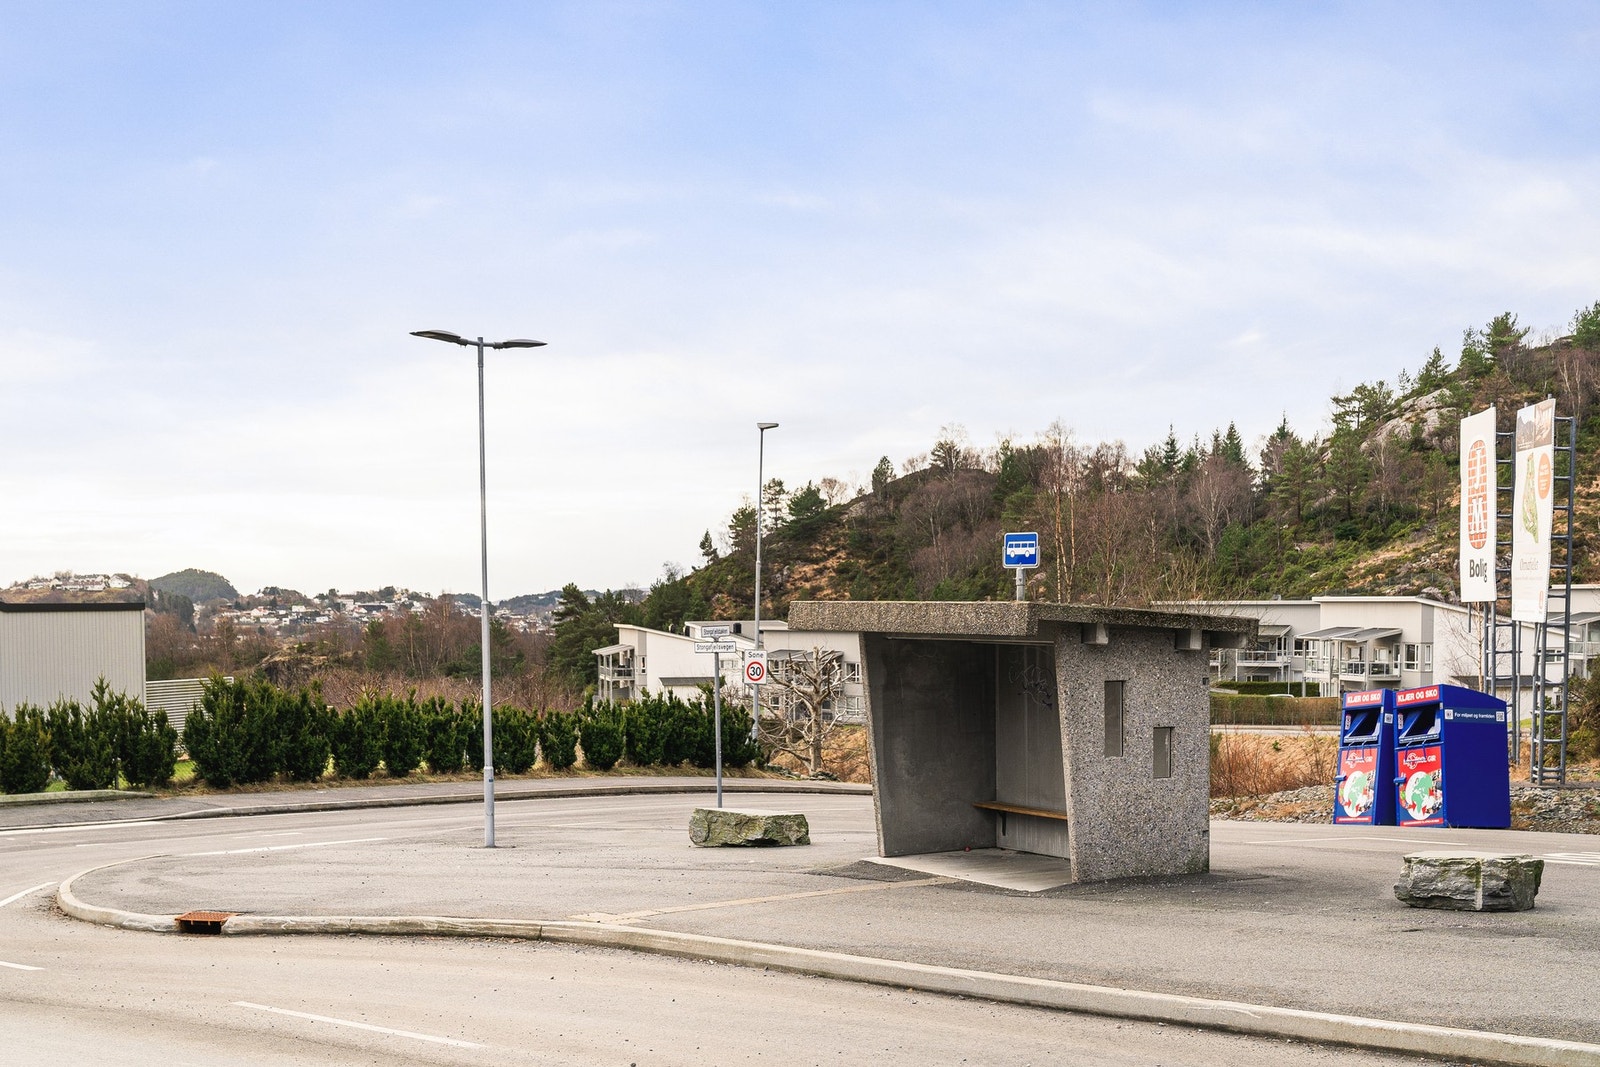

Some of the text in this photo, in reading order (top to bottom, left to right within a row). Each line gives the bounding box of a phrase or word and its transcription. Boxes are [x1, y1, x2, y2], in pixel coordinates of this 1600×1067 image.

[1469, 558, 1488, 584] Bolig
[750, 666, 761, 676] 30
[1347, 693, 1381, 704] KLÆR OG SKO
[1397, 689, 1438, 703] KLÆR OG SKO
